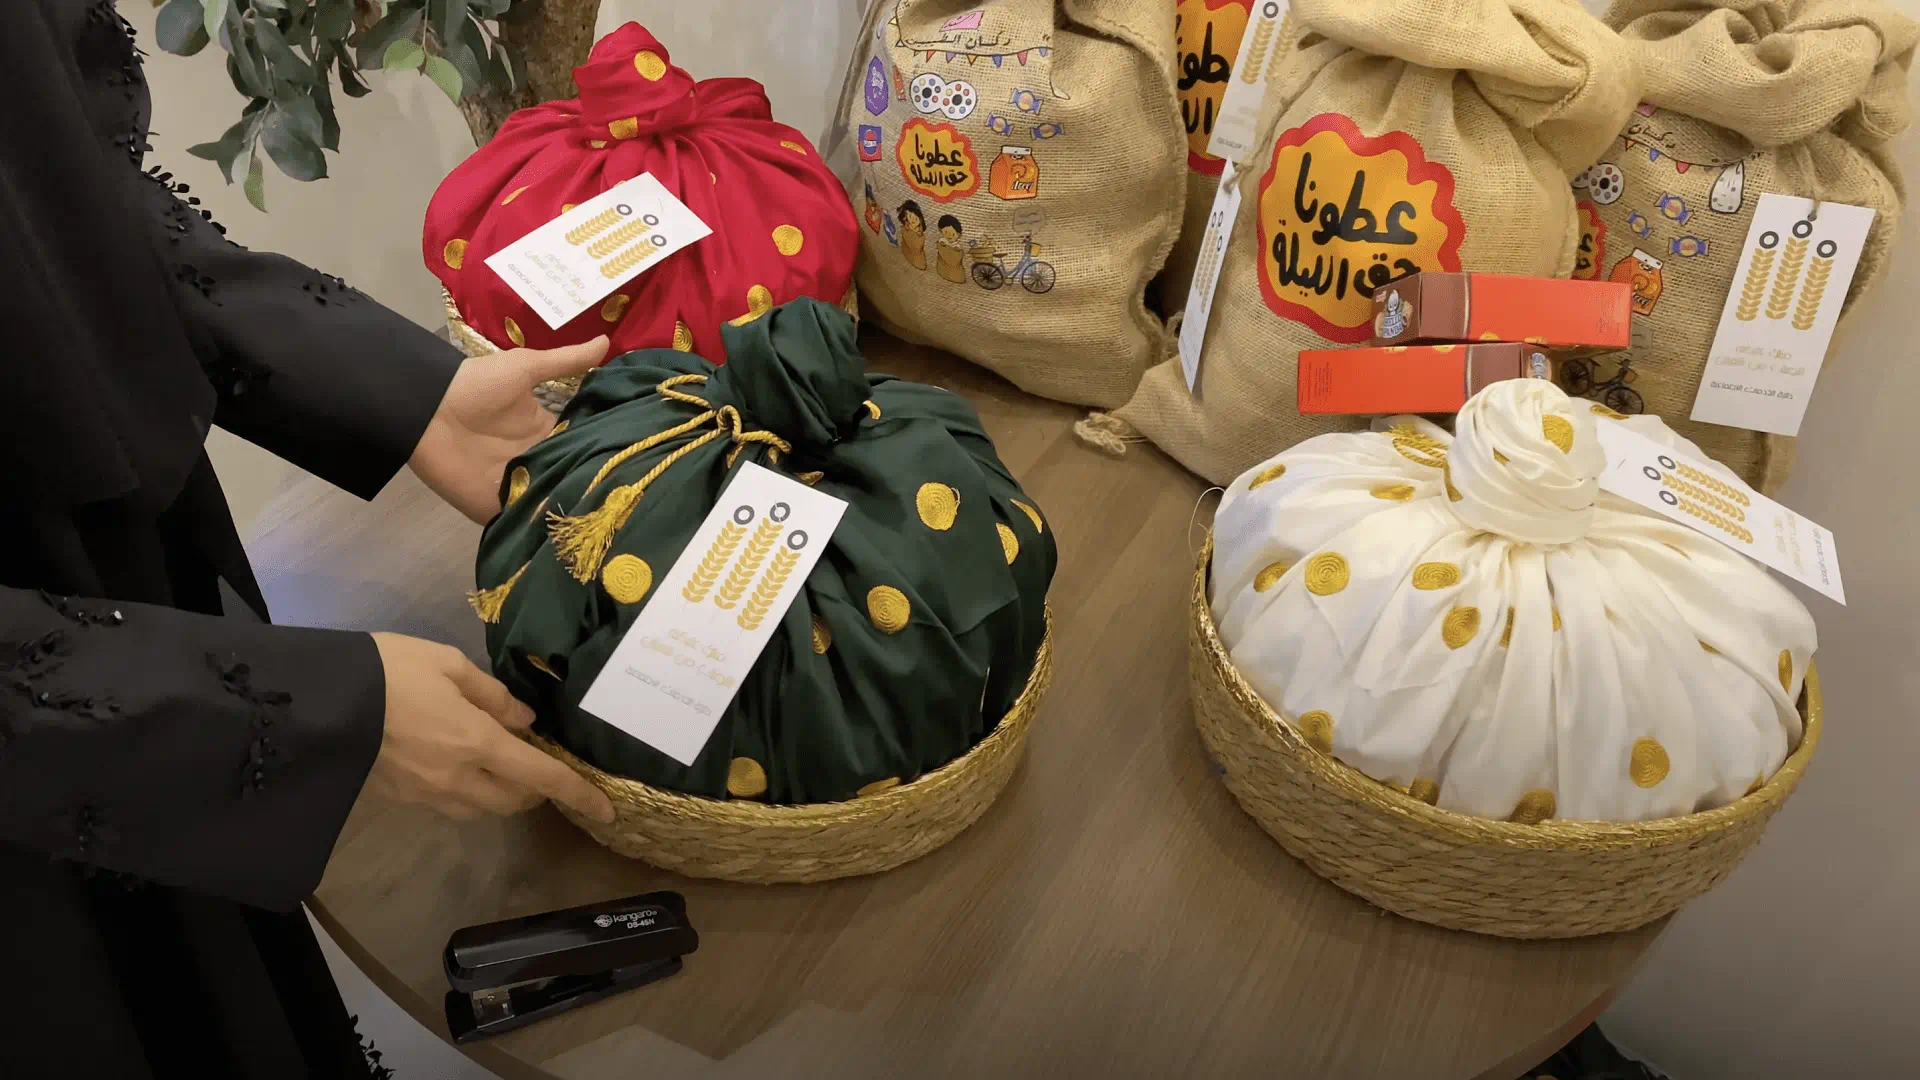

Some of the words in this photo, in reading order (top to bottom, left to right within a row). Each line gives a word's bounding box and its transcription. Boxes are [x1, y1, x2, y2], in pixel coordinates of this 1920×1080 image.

[914, 132, 964, 168] عطونا
[910, 159, 943, 187] الليلة
[945, 169, 969, 186] حق
[1294, 151, 1419, 246] عطونا
[1272, 219, 1350, 301] الليلة
[1353, 252, 1422, 300] حق
[613, 910, 651, 923] kangaro
[627, 918, 654, 929] DS-45N
